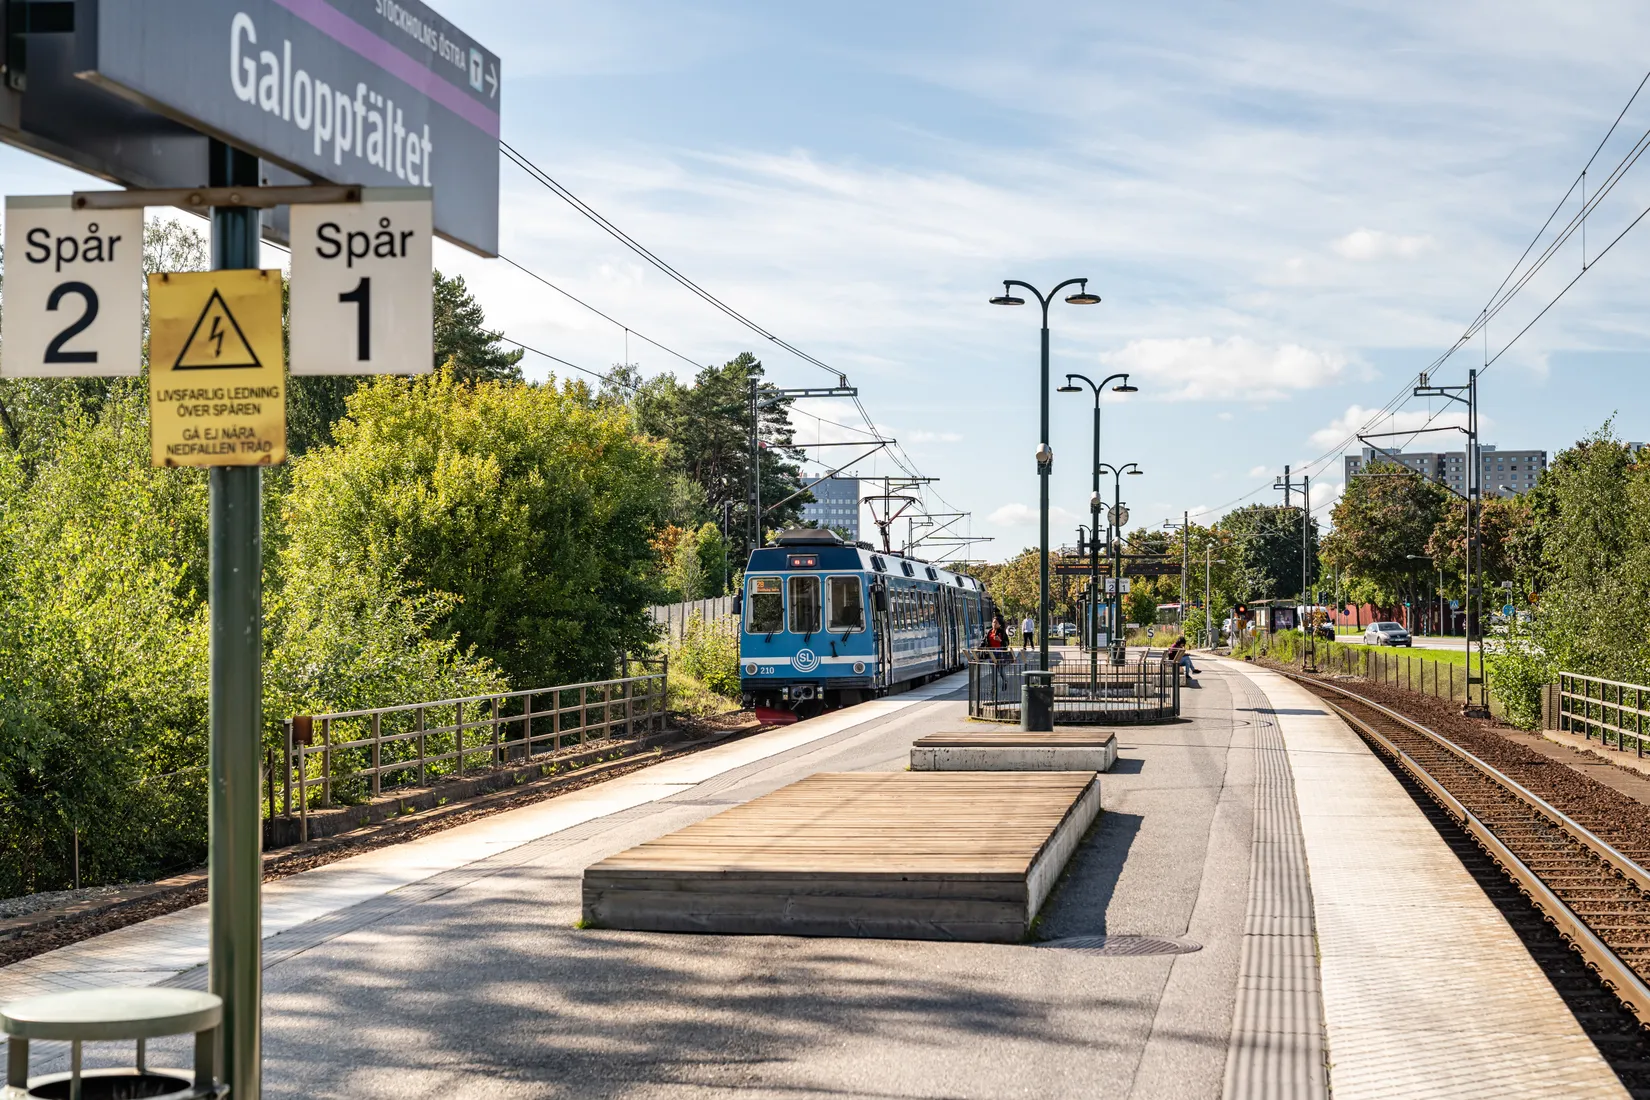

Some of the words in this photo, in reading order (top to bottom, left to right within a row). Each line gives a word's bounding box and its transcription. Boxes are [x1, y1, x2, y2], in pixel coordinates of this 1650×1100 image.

[439, 32, 467, 72] ÖSTRA
[230, 12, 433, 188] Galoppfältet
[25, 222, 122, 273] Spår
[316, 217, 414, 269] Spår
[43, 281, 100, 364] 2
[338, 277, 371, 362] 1
[156, 387, 224, 402] LIVSFARLIG
[227, 386, 280, 400] LEDNING
[176, 403, 211, 417] ÖVER
[212, 401, 262, 416] SPÅREN
[182, 425, 200, 441] GÅ
[204, 428, 218, 440] EJ
[221, 424, 256, 440] NÄRA
[166, 442, 236, 456] NEDFALLEN
[240, 438, 273, 453] TRÅD
[1108, 584, 1115, 592] 2
[1122, 584, 1126, 592] 1
[1008, 627, 1015, 637] S
[1147, 627, 1154, 638] S
[799, 652, 812, 662] SL
[760, 666, 775, 675] 210
